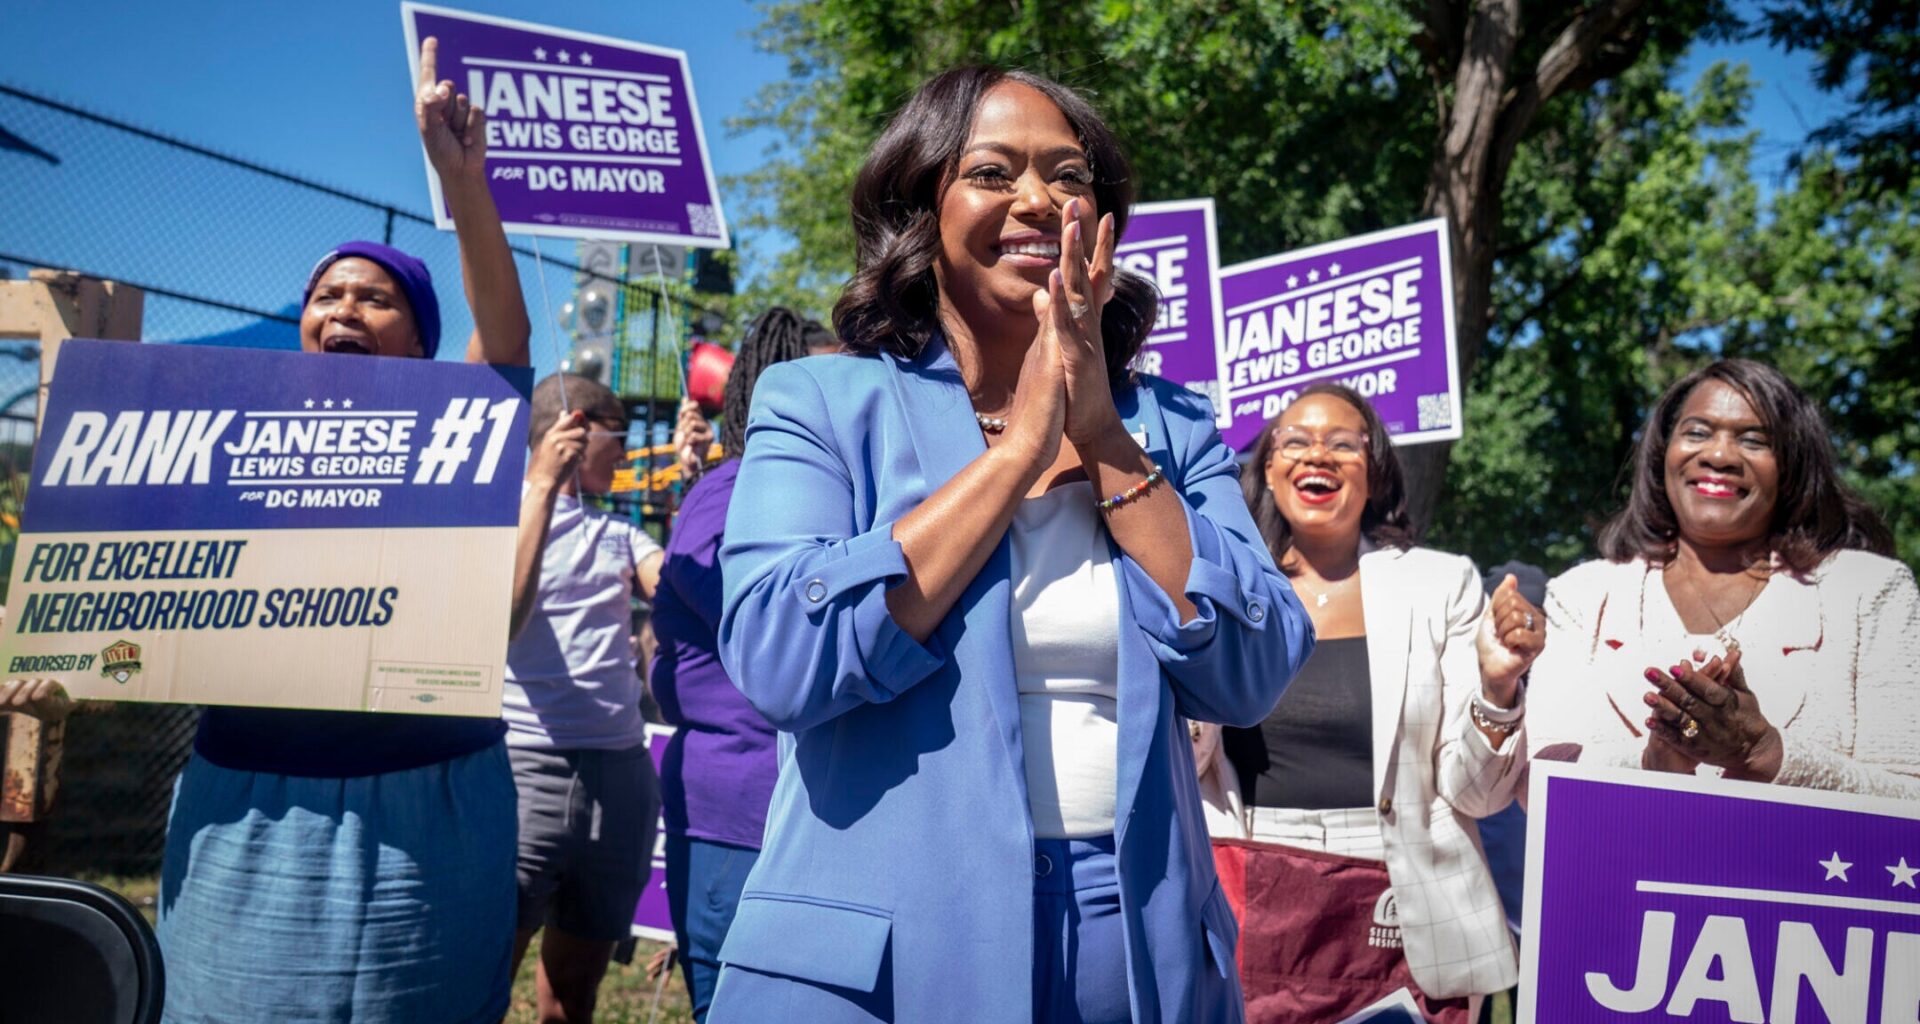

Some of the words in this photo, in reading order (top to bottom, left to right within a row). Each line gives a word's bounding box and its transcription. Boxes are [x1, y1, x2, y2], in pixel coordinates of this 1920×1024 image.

[486, 120, 563, 149] EWIS
[569, 123, 680, 154] GEORGE
[492, 166, 525, 180] FOR
[527, 165, 569, 191] DC
[571, 166, 665, 193] MAYOR
[1226, 268, 1422, 363] JANEESE
[1306, 316, 1421, 368] GEORGE
[1341, 368, 1397, 398] YOR
[41, 410, 237, 486] RANK
[224, 419, 416, 455] JANEESE
[412, 398, 520, 484] #1
[229, 456, 305, 477] LEWIS
[311, 455, 409, 476] GEORGE
[239, 491, 266, 501] FOR
[265, 489, 299, 508] DC
[300, 488, 382, 508] MAYOR
[23, 542, 90, 583] FOR
[87, 540, 248, 581] EXCELLENT
[16, 589, 260, 634] NEIGHBORHOOD
[258, 586, 399, 629] SCHOOLS
[8, 654, 77, 673] ENDORSED
[77, 653, 97, 671] BY
[1369, 926, 1401, 939] SIERR
